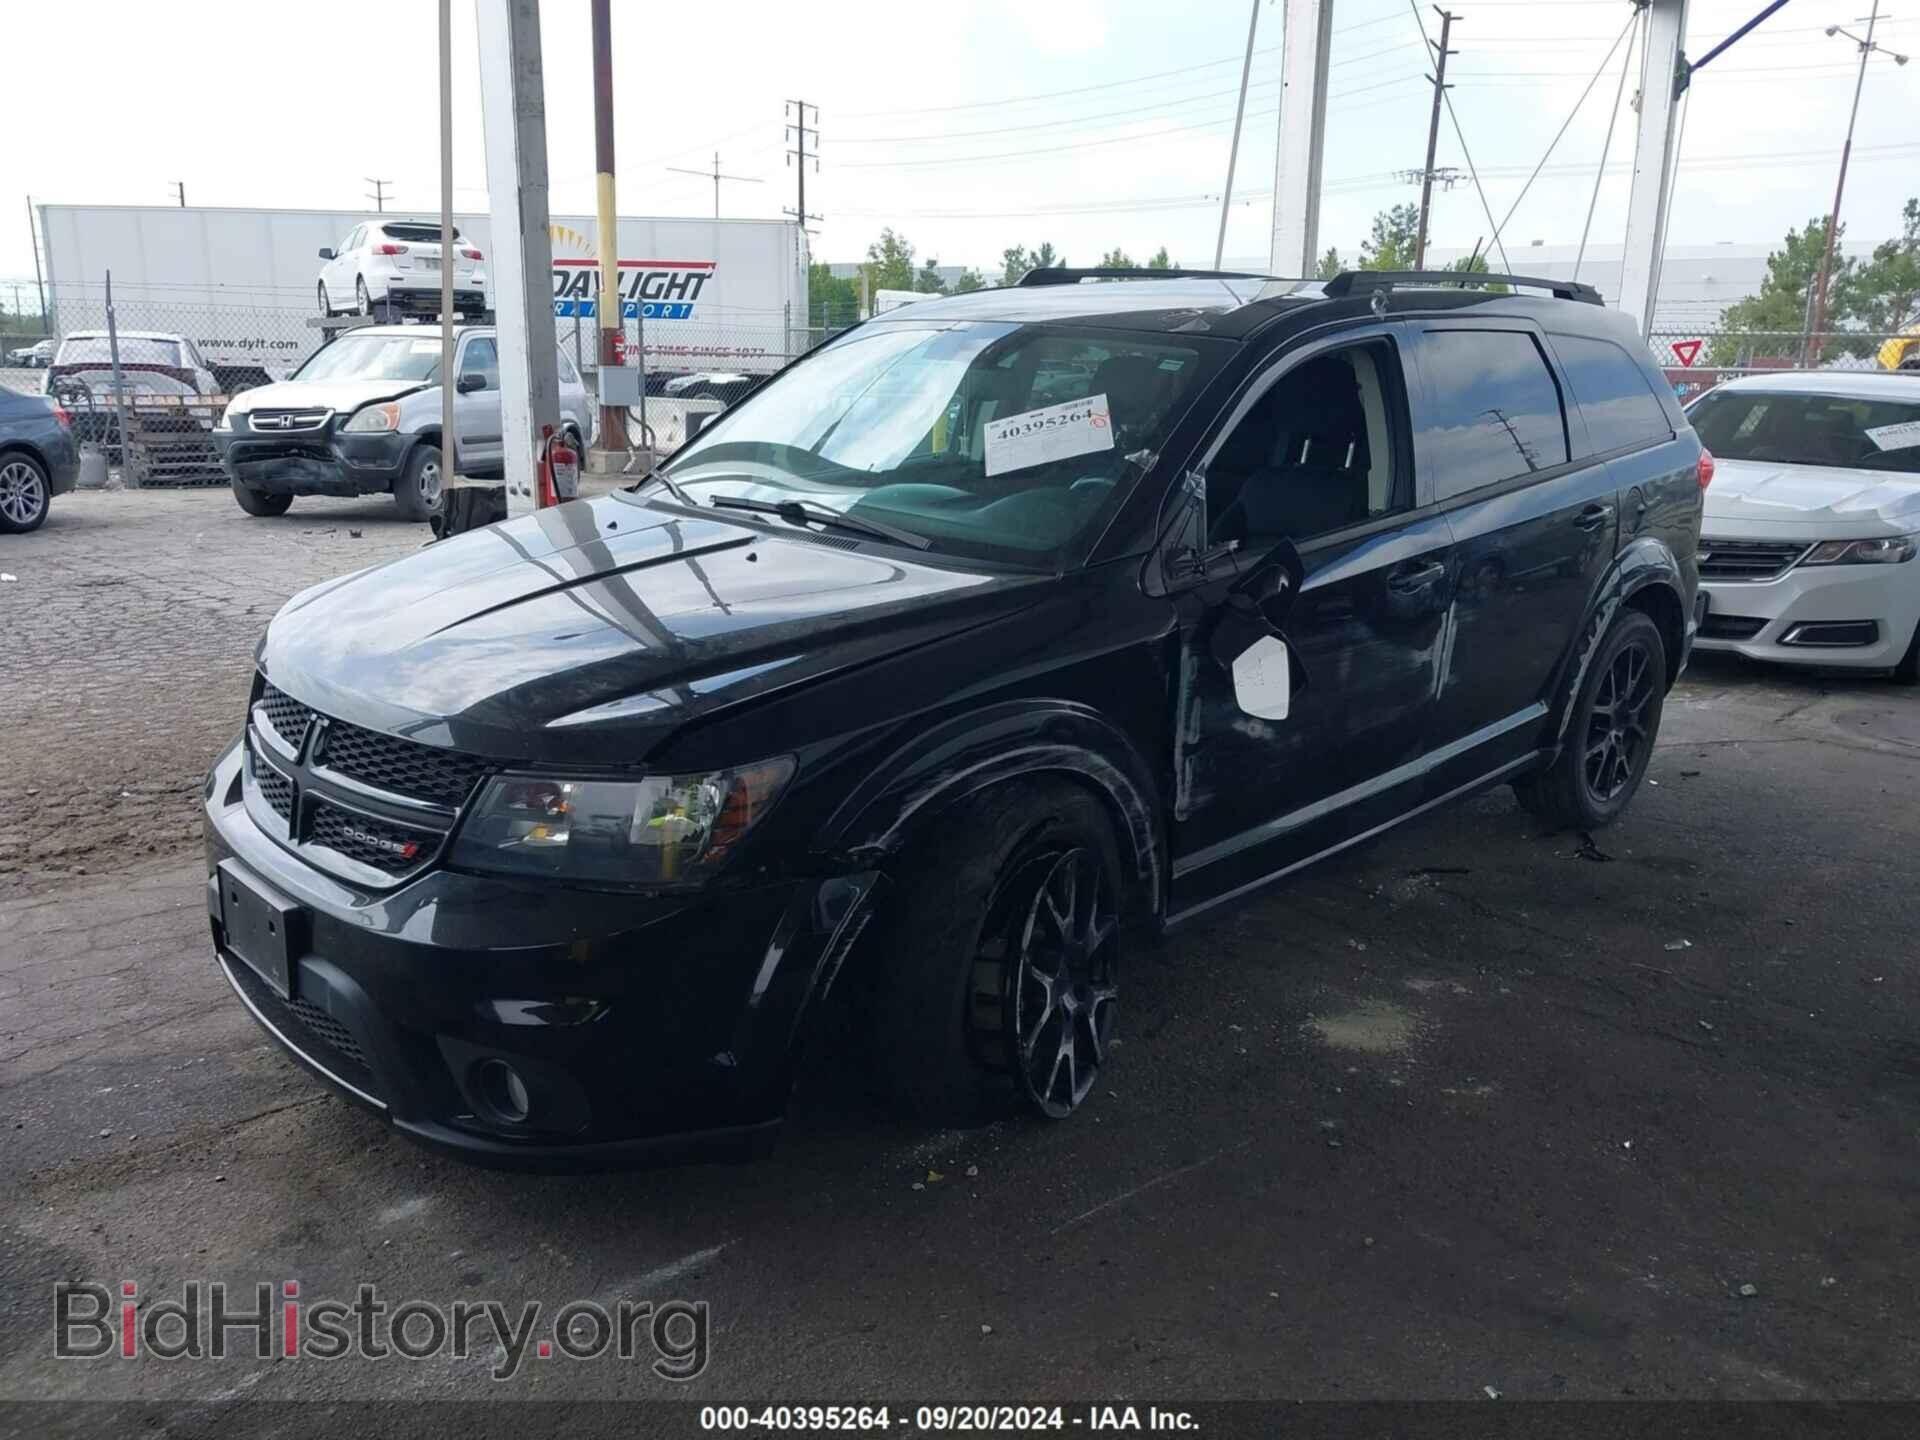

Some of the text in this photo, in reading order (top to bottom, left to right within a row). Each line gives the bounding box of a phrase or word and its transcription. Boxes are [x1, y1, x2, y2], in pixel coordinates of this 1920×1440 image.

[197, 337, 298, 351] www.dylt.com
[997, 408, 1092, 439] 40395264
[343, 826, 404, 854] DODGE
